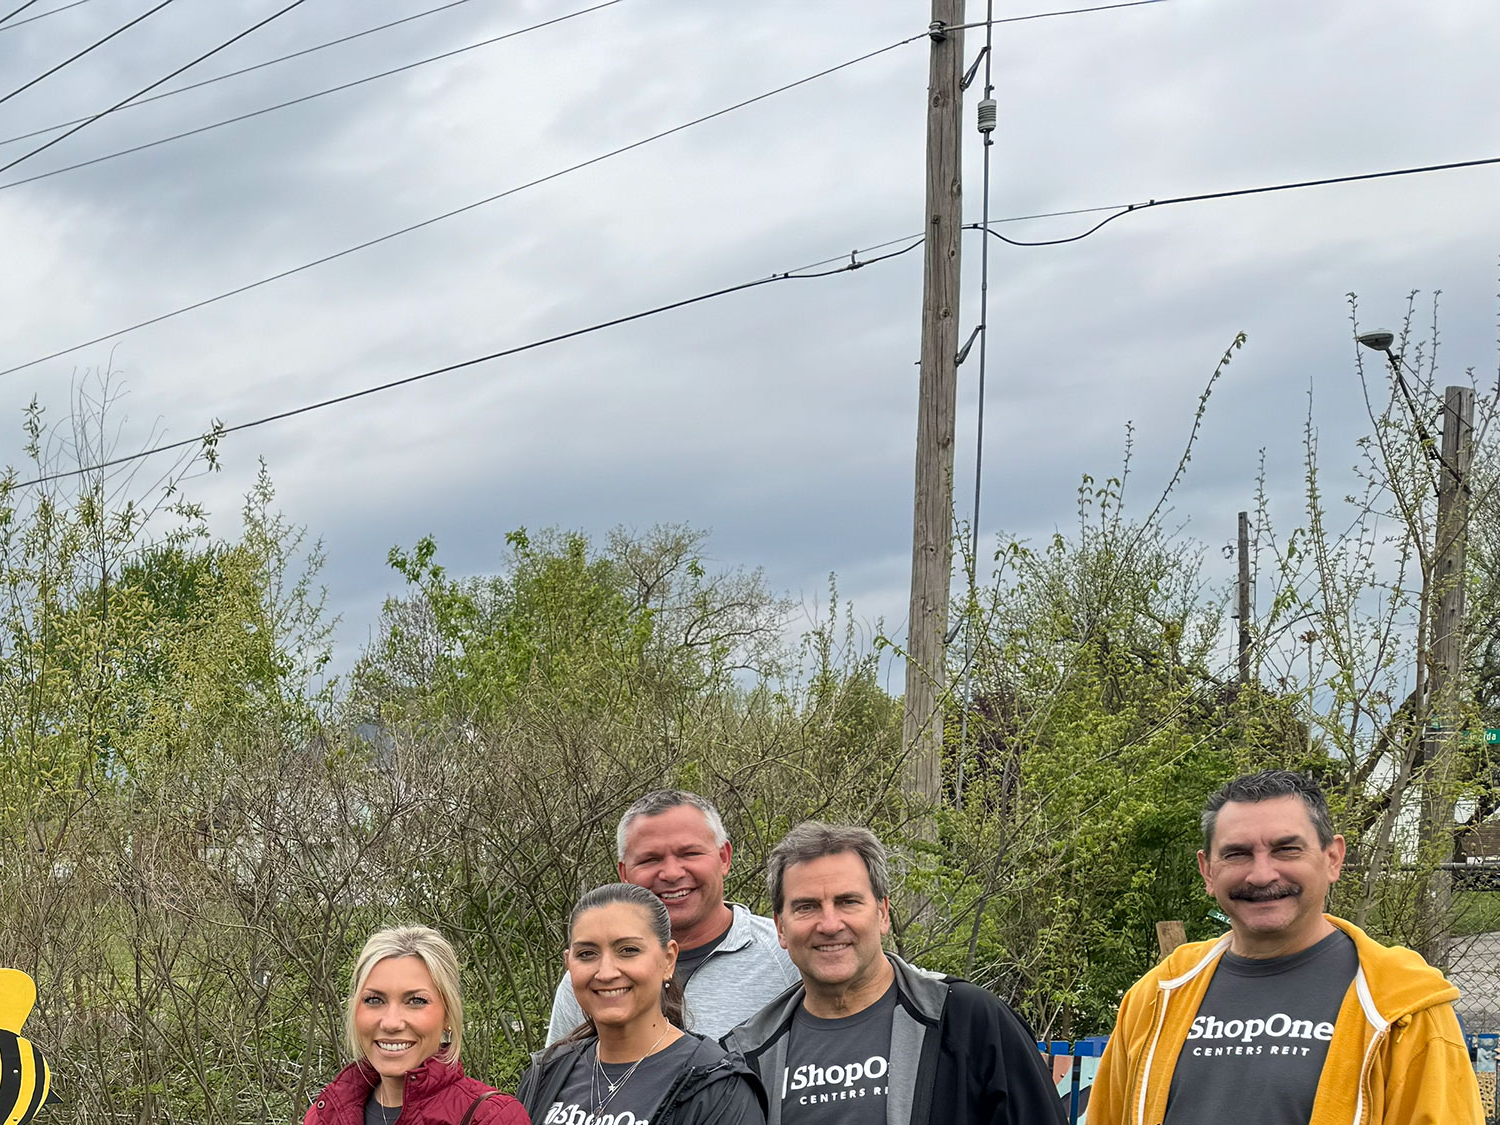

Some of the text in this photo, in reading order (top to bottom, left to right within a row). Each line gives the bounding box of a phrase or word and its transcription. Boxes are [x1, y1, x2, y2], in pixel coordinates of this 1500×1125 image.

[1186, 1013, 1335, 1043] ShopOne
[1192, 1045, 1310, 1057] CENTERS REIT
[790, 1055, 890, 1091] ShopO
[799, 1087, 866, 1106] CENTERS
